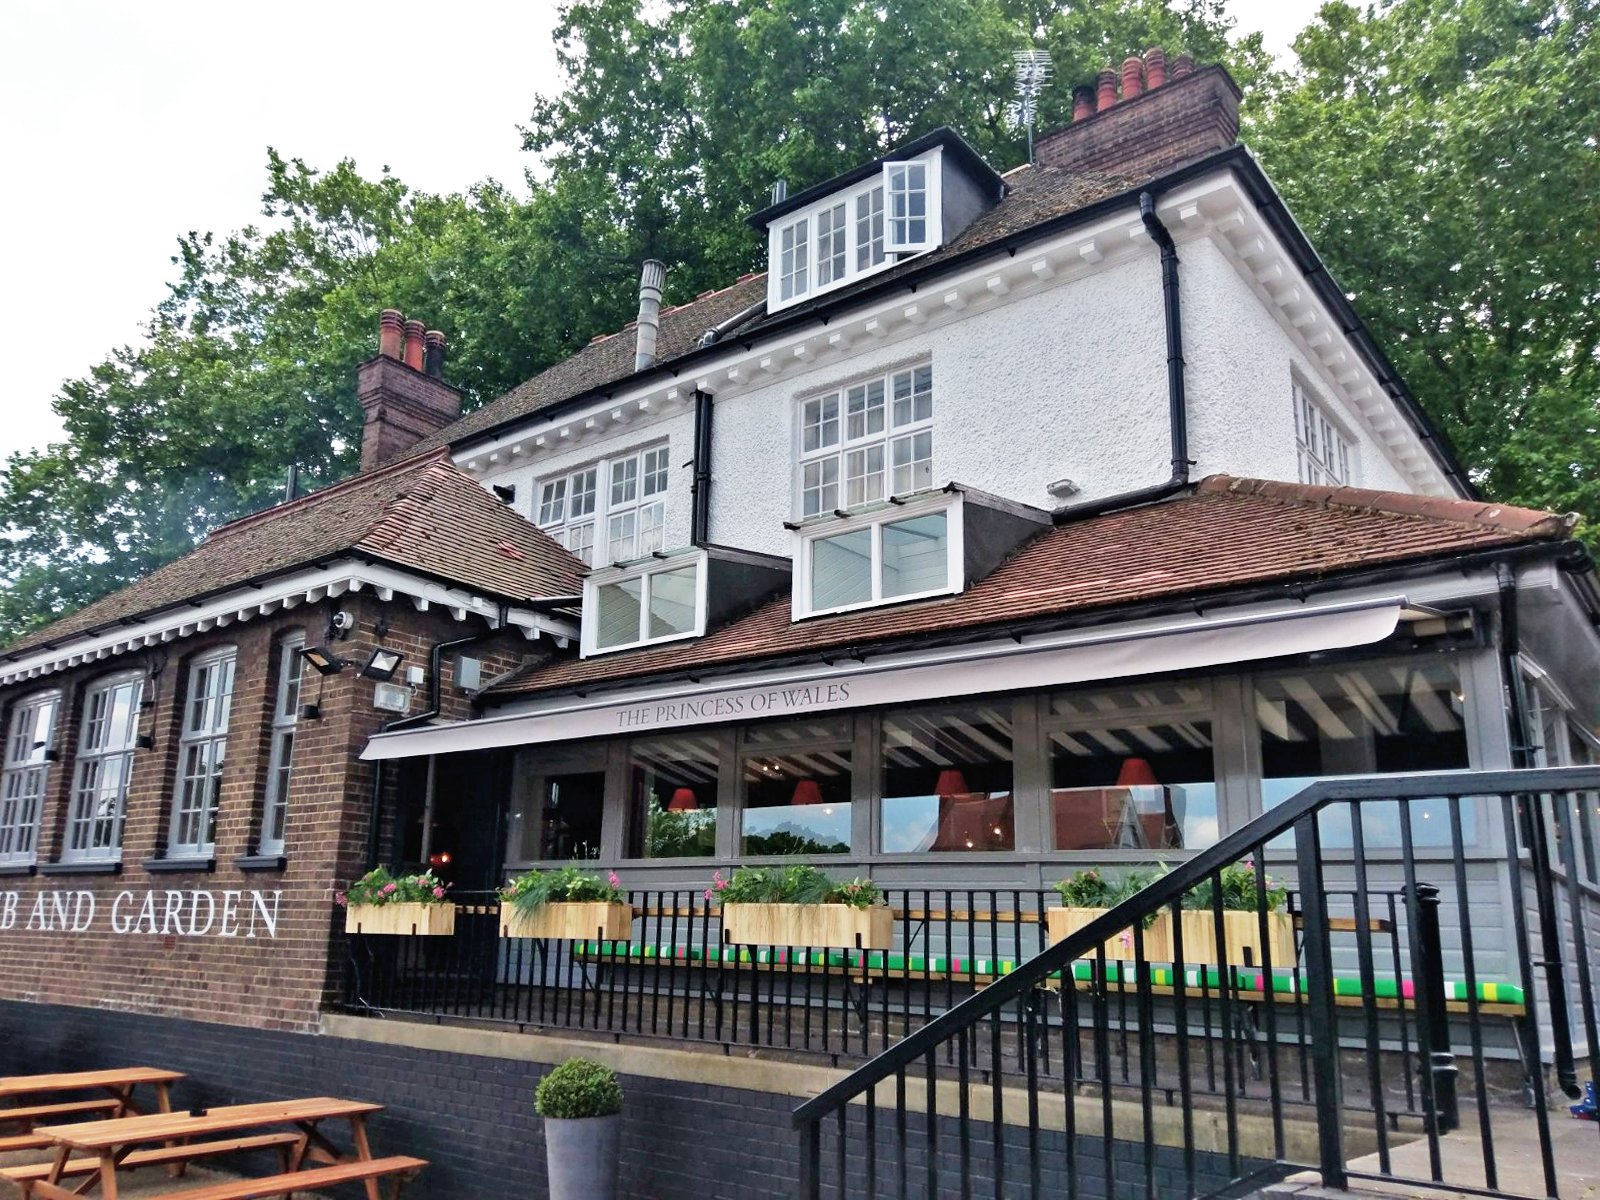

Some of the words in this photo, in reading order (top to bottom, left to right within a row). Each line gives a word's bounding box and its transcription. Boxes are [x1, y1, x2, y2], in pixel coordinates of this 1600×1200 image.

[616, 708, 650, 727] THE
[655, 696, 744, 722] PRINCESS
[750, 693, 777, 711] OF
[782, 682, 851, 709] WALES
[0, 890, 19, 930] B
[26, 890, 96, 932] AND
[111, 889, 283, 938] GARDEN
